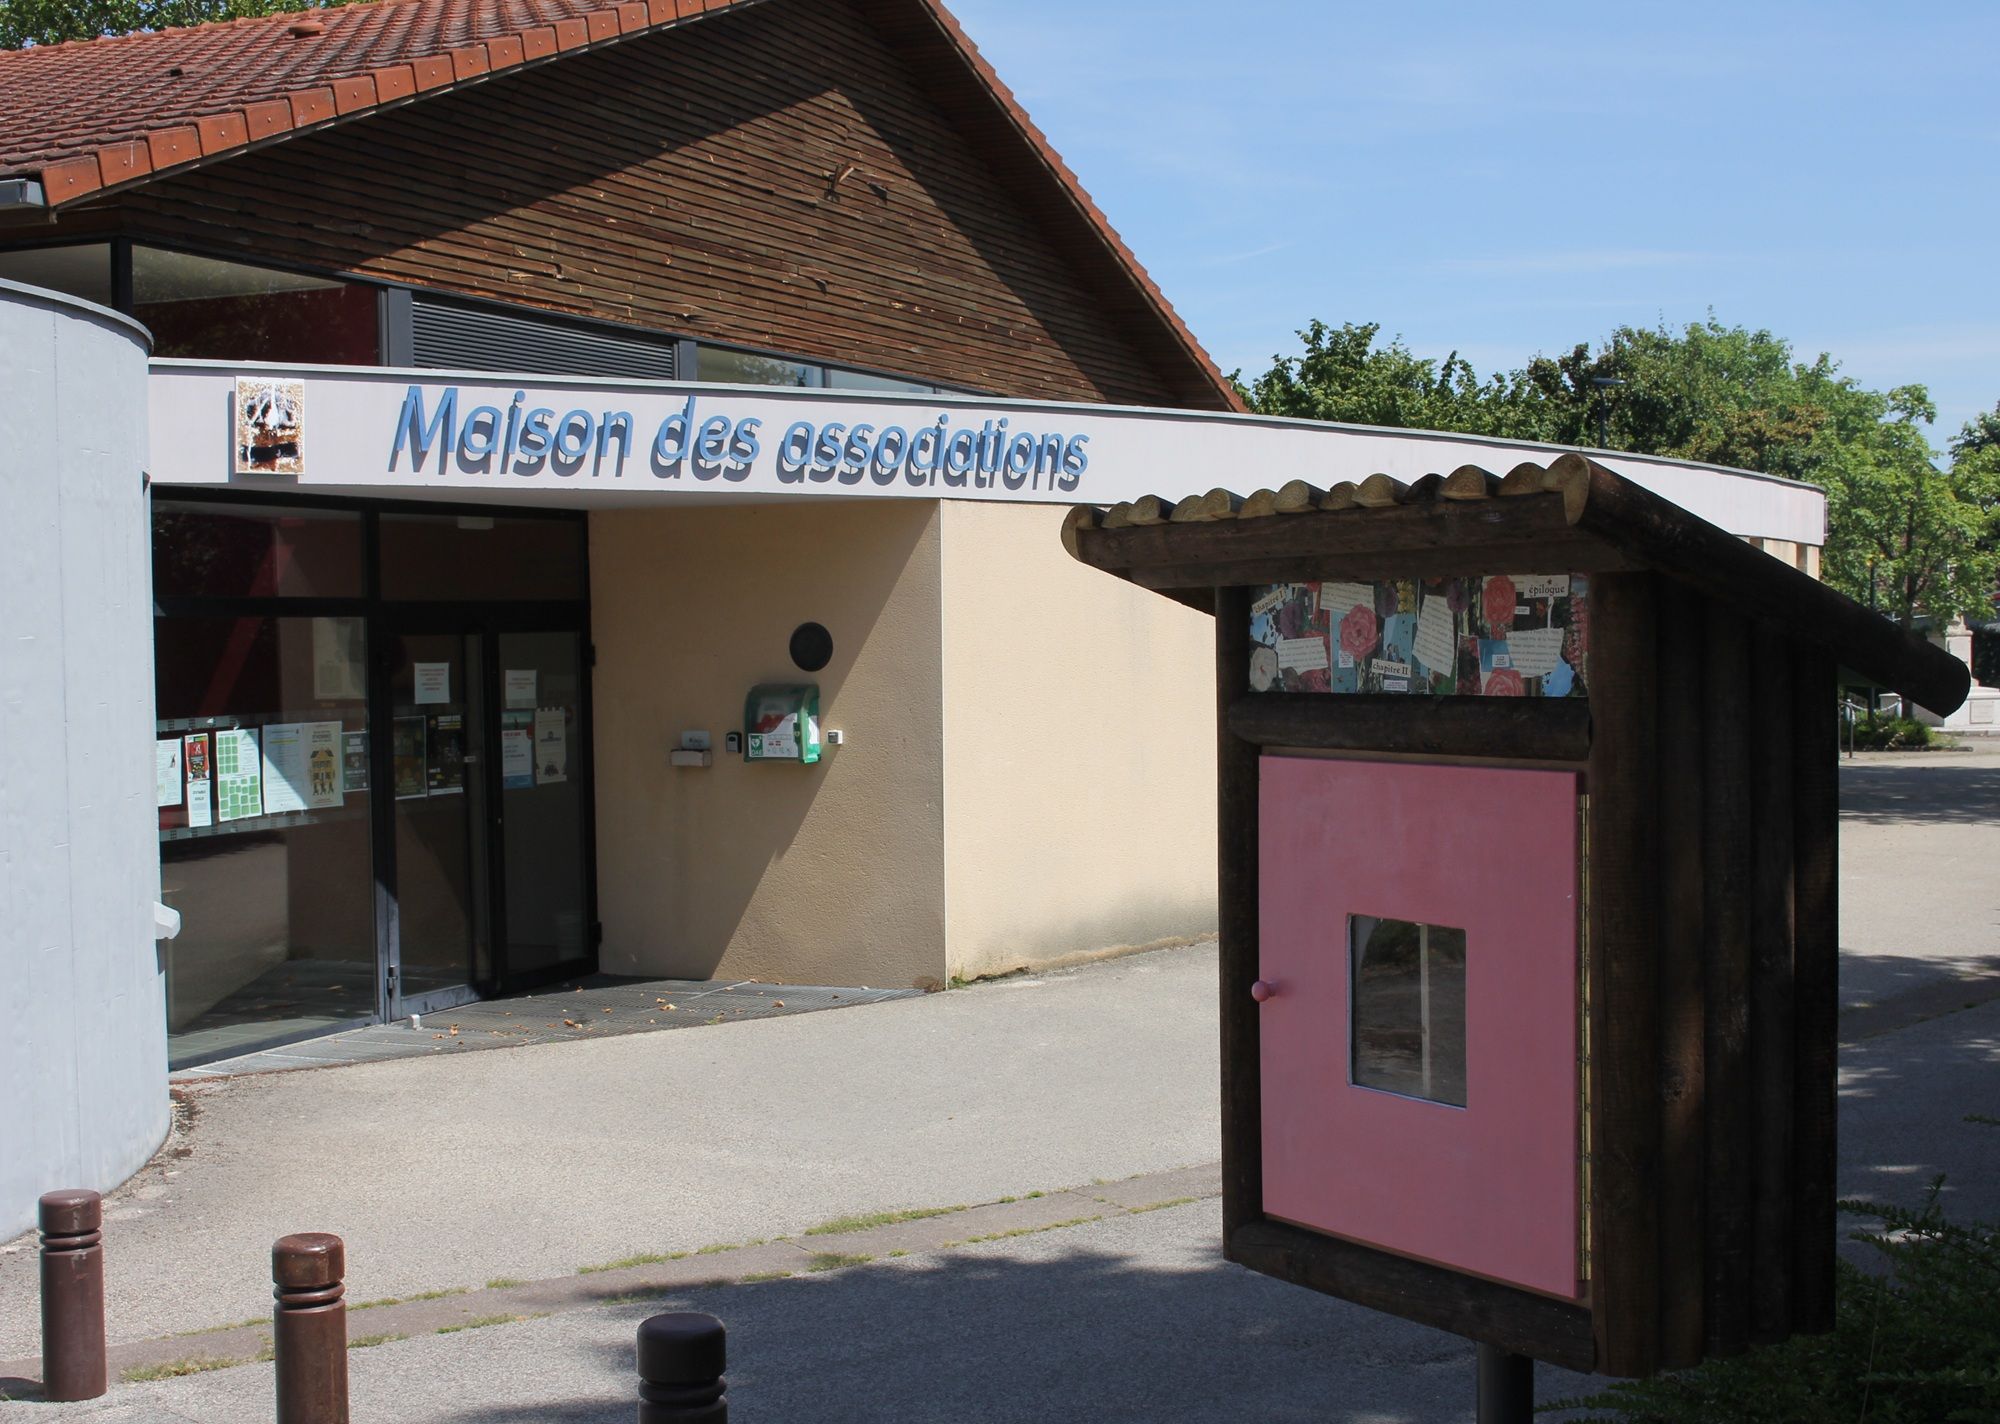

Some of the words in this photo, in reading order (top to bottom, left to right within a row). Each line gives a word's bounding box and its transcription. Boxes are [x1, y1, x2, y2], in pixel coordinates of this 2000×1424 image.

[397, 384, 634, 459] Maison
[655, 395, 763, 465] des
[782, 413, 1090, 477] associations
[1528, 583, 1566, 597] épilogue
[1372, 661, 1401, 674] chapitre
[1401, 666, 1409, 675] II
